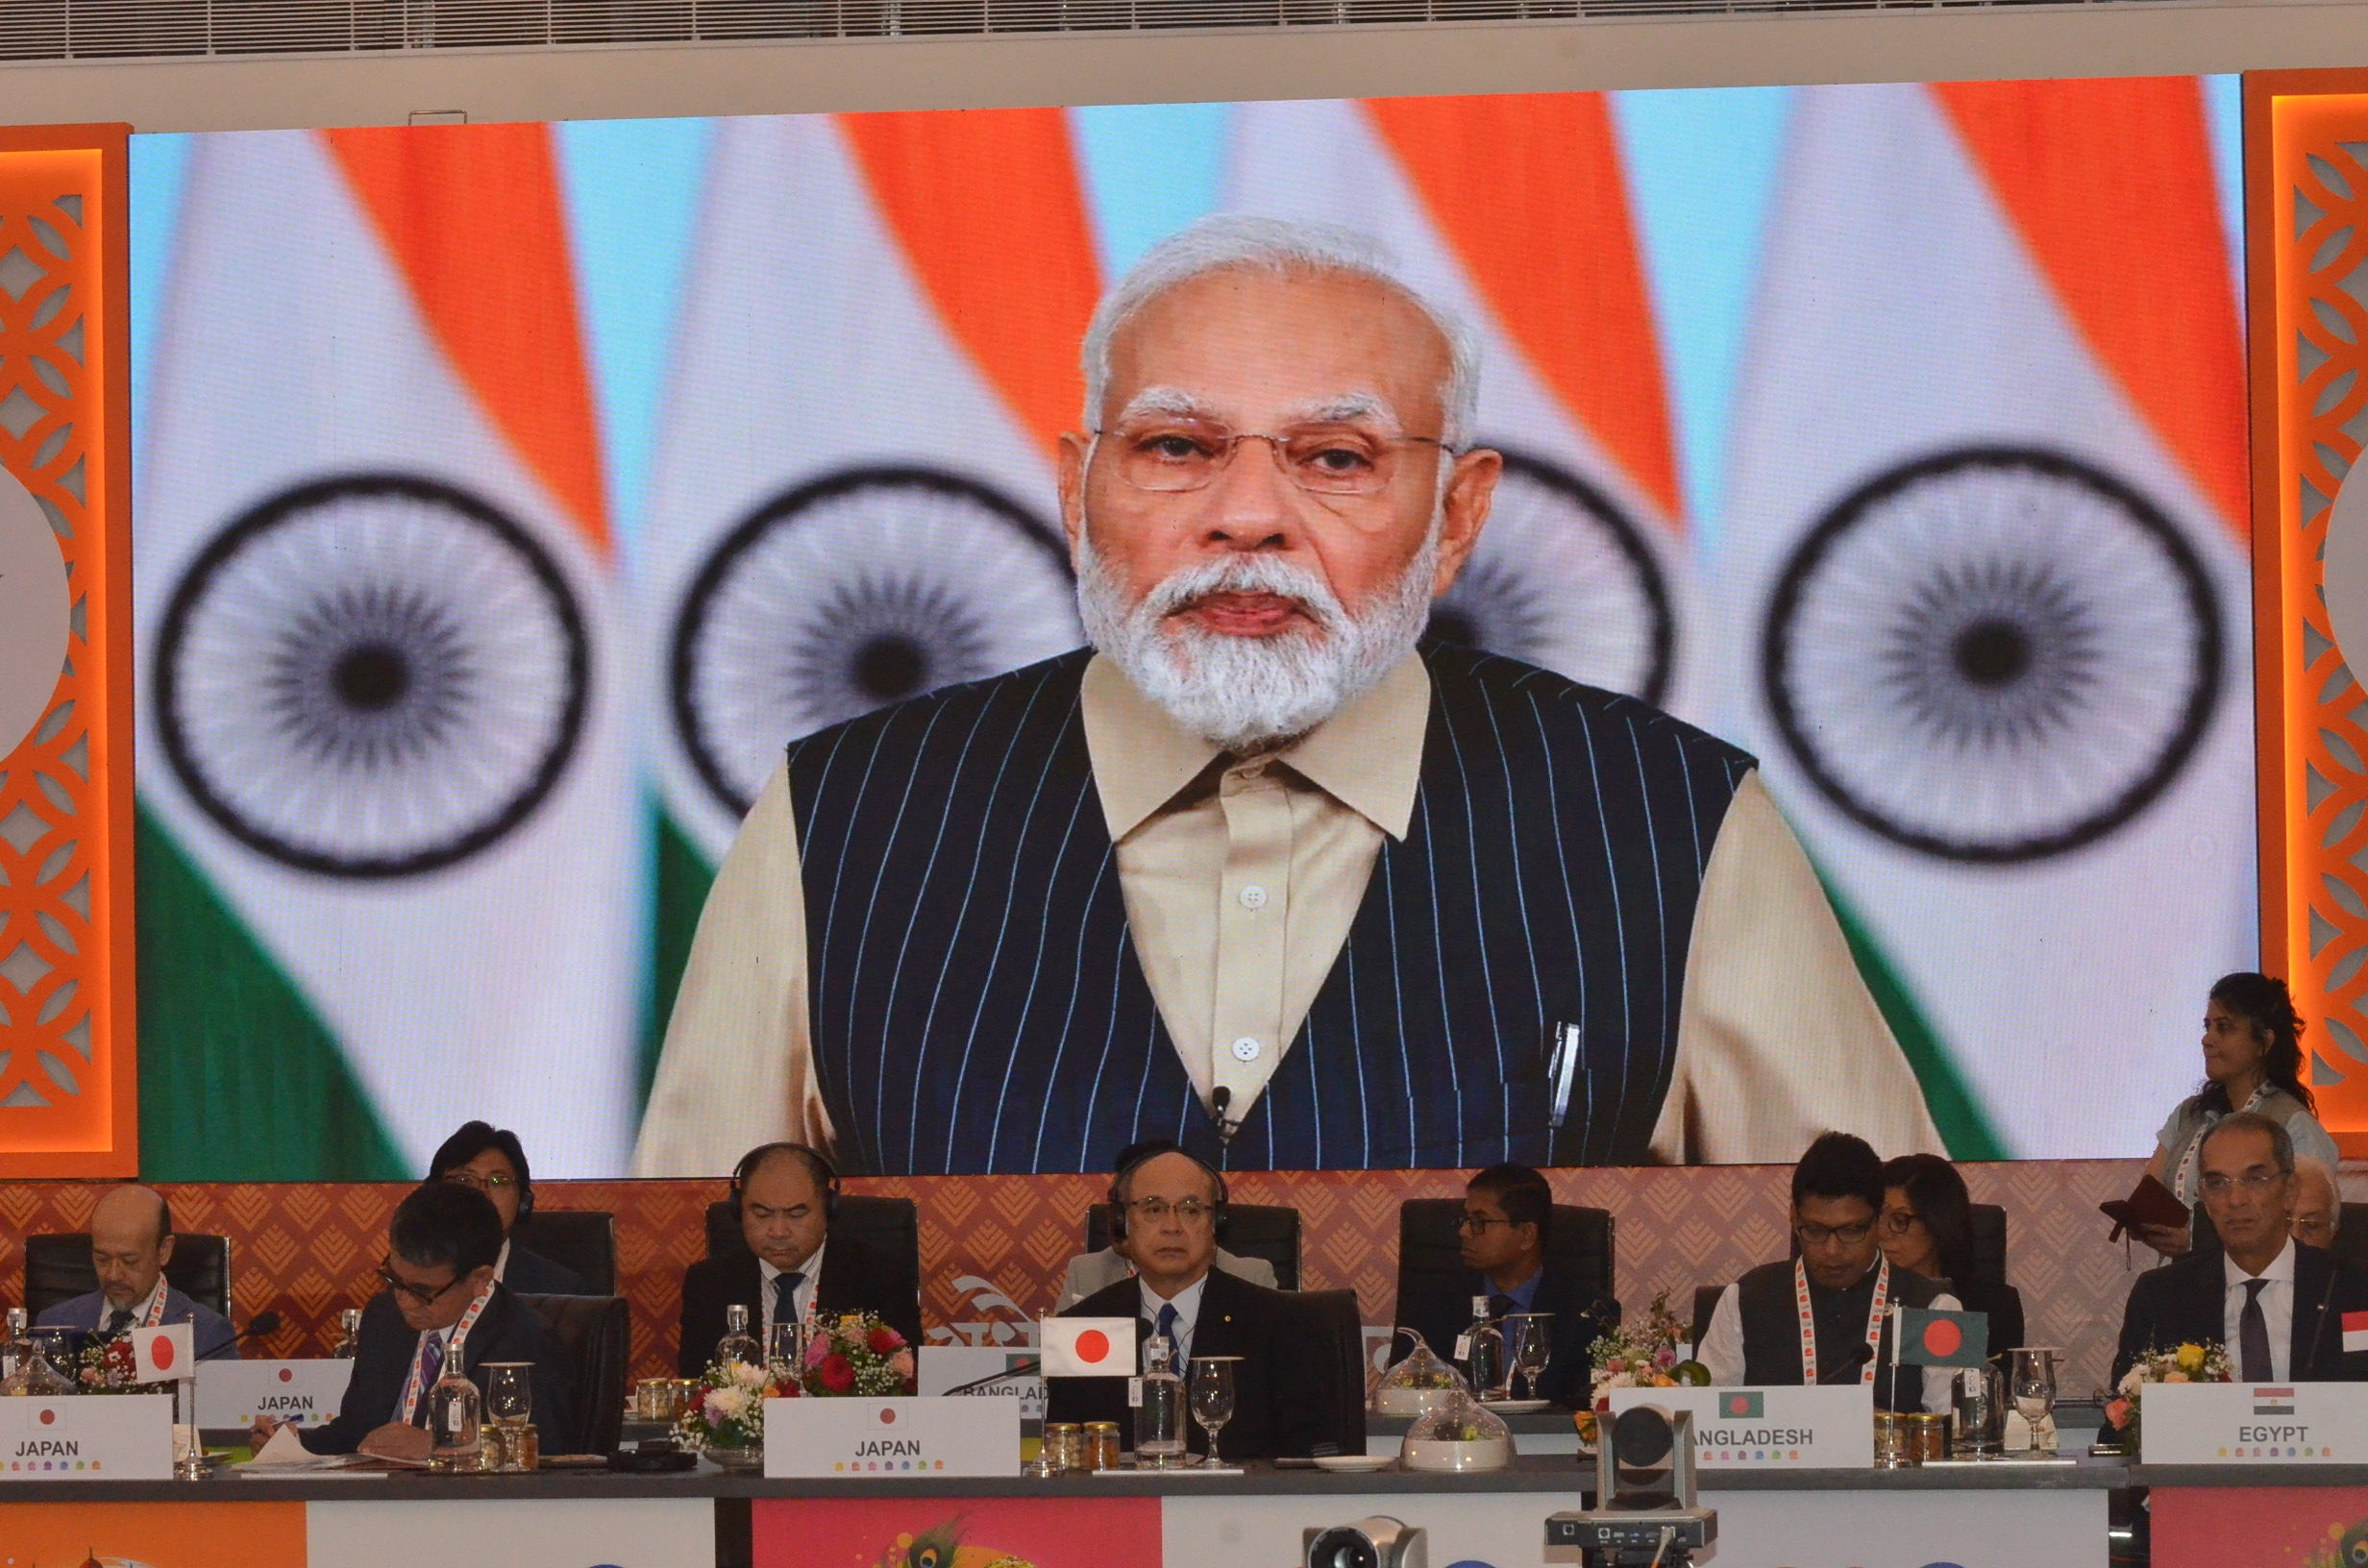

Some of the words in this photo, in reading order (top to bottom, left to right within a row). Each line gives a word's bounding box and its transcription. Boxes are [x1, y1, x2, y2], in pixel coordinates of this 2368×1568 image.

[964, 1385, 1048, 1400] BANGLAD
[258, 1395, 313, 1410] JAPAN
[1694, 1429, 1813, 1447] NGLADESH
[2238, 1426, 2308, 1443] EGYPT
[15, 1440, 79, 1458] JAPAN
[854, 1439, 921, 1458] JAPAN
